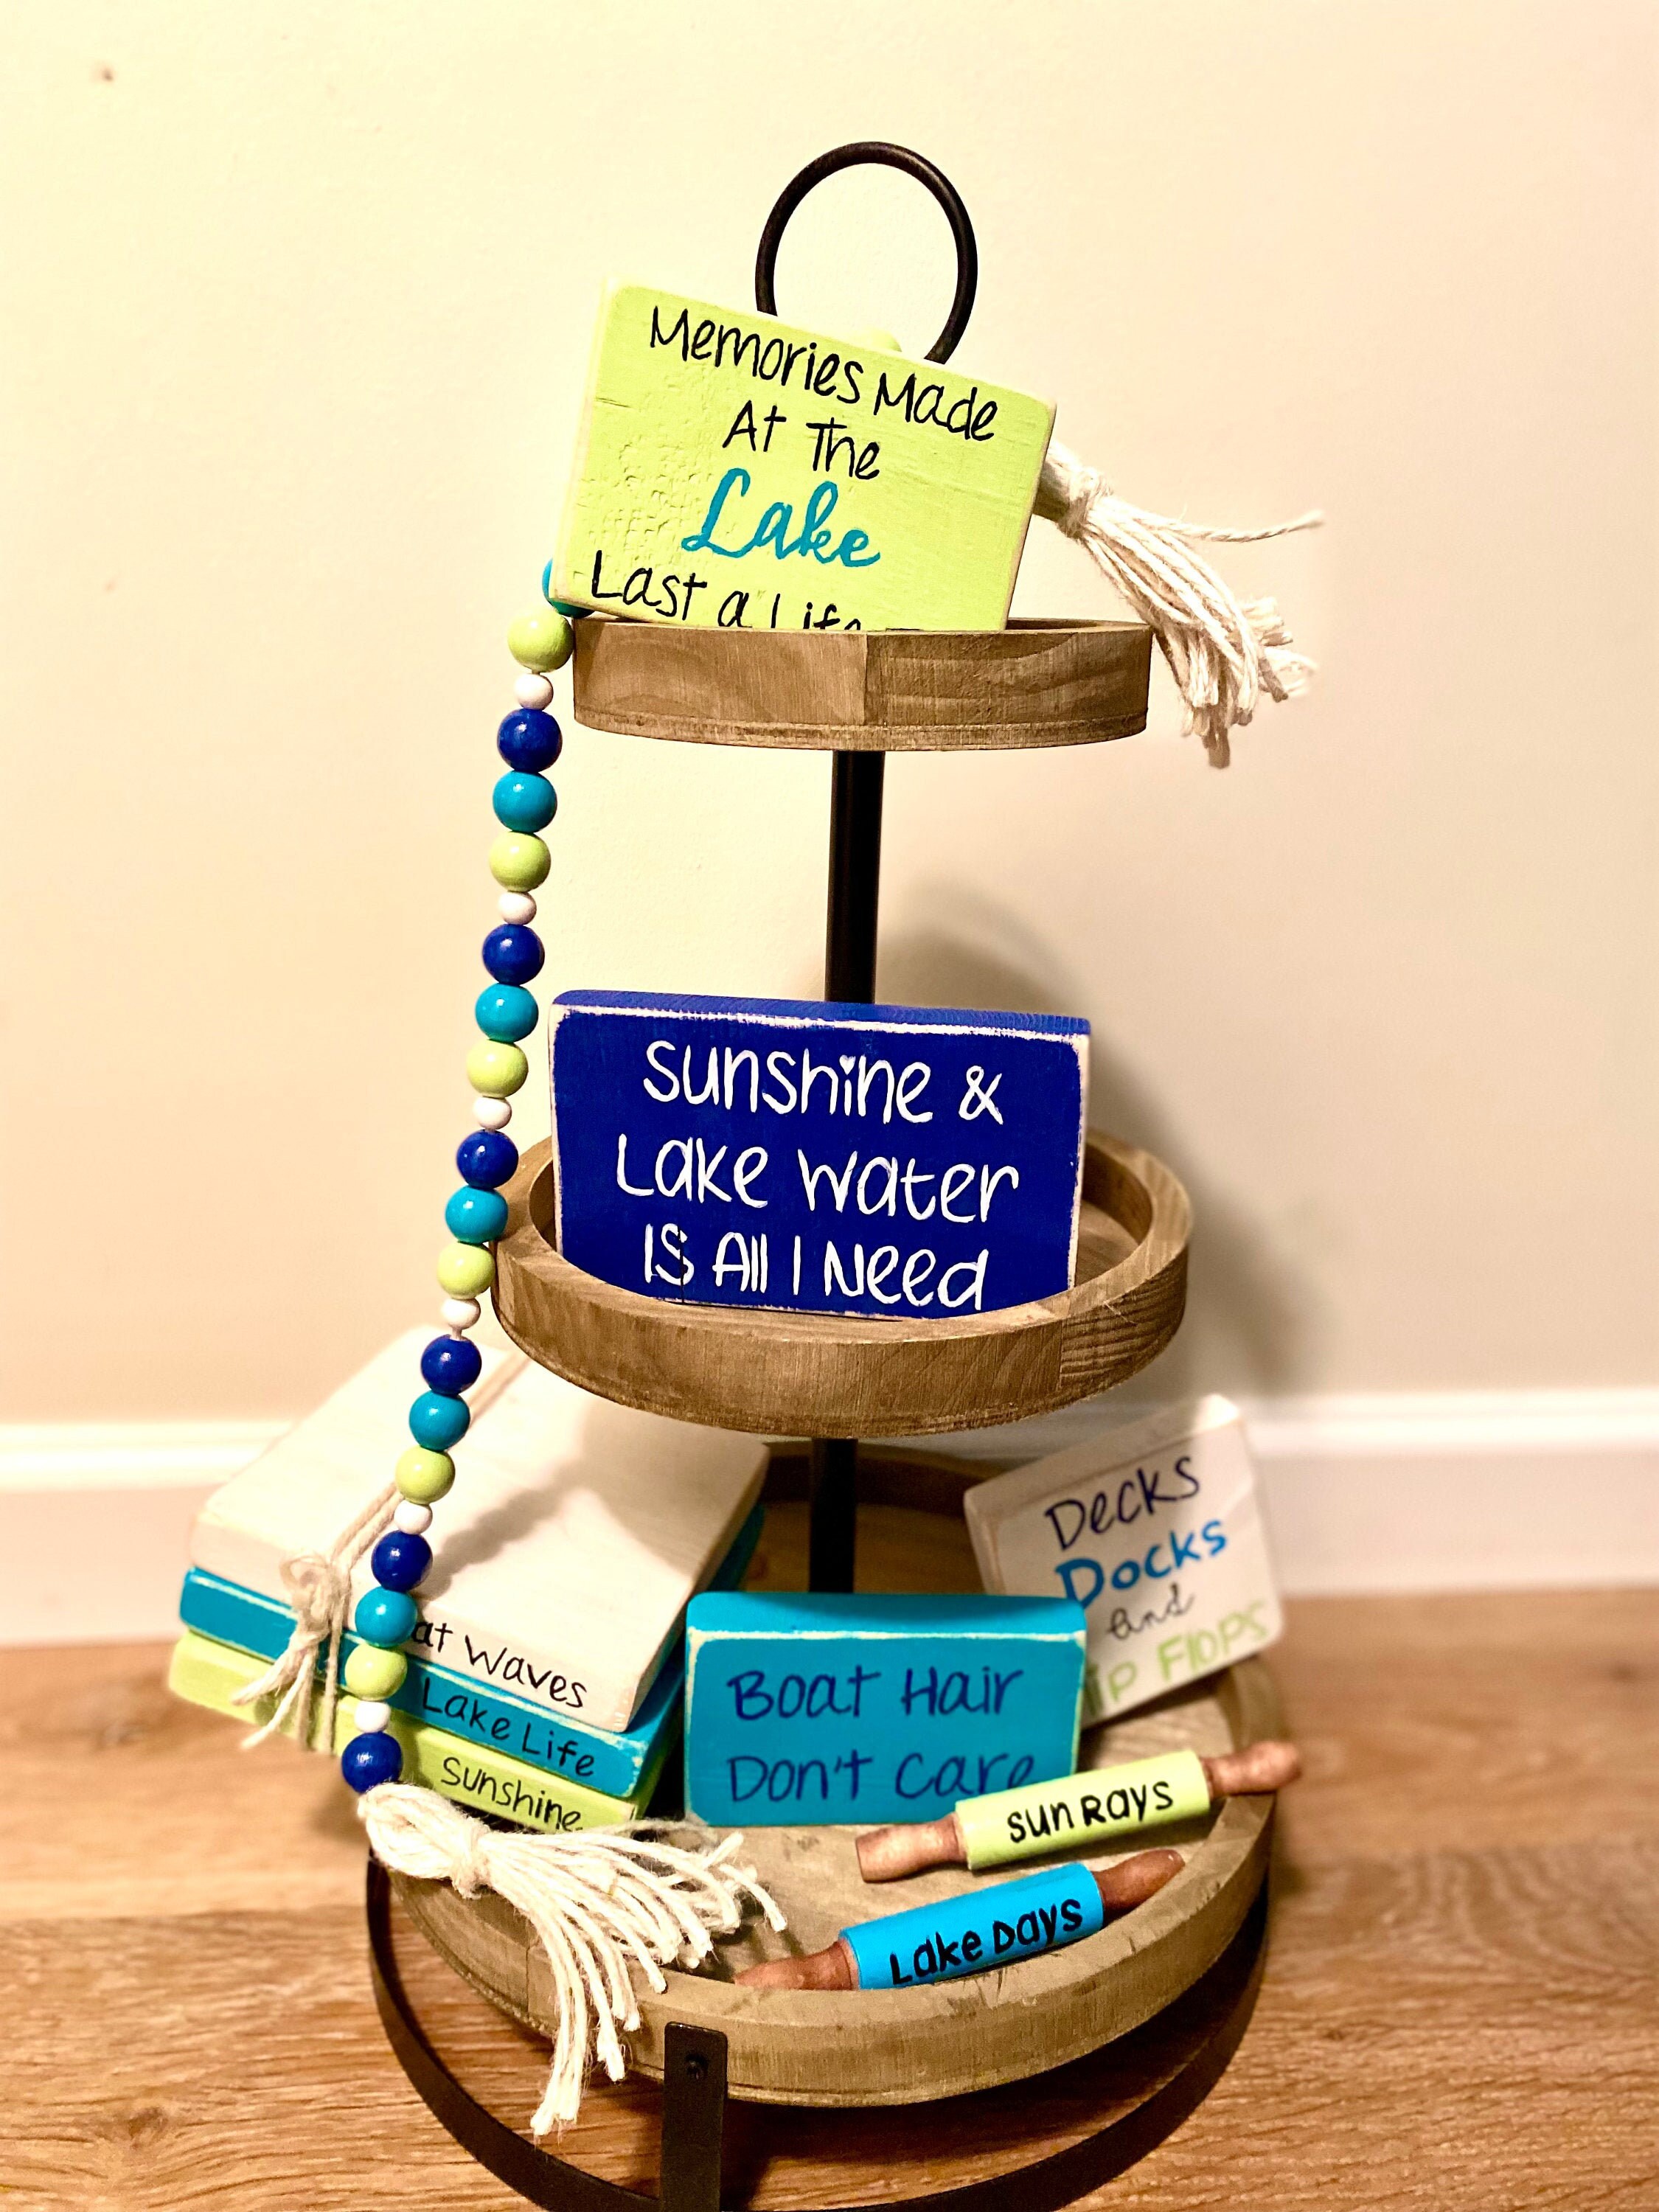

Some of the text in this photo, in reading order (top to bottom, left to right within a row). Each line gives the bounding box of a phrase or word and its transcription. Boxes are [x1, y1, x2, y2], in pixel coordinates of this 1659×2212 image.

[651, 304, 998, 442] Memories Made
[722, 400, 881, 480] At The
[681, 467, 882, 568] Lake
[591, 550, 707, 621] Last
[717, 591, 752, 628] a
[958, 1065, 1005, 1125] &
[616, 1133, 1020, 1223] Lake Water
[712, 1231, 768, 1294] All
[792, 1235, 801, 1295] I
[824, 1239, 990, 1312] Need
[1106, 1583, 1196, 1641] and
[411, 1621, 588, 1708] at Waves
[726, 1664, 1024, 1721] Boat Hair
[422, 1676, 596, 1778] Lake Life
[440, 1756, 584, 1833] Sunshine
[727, 1747, 873, 1803] Don't
[889, 1929, 983, 1986] Lake
